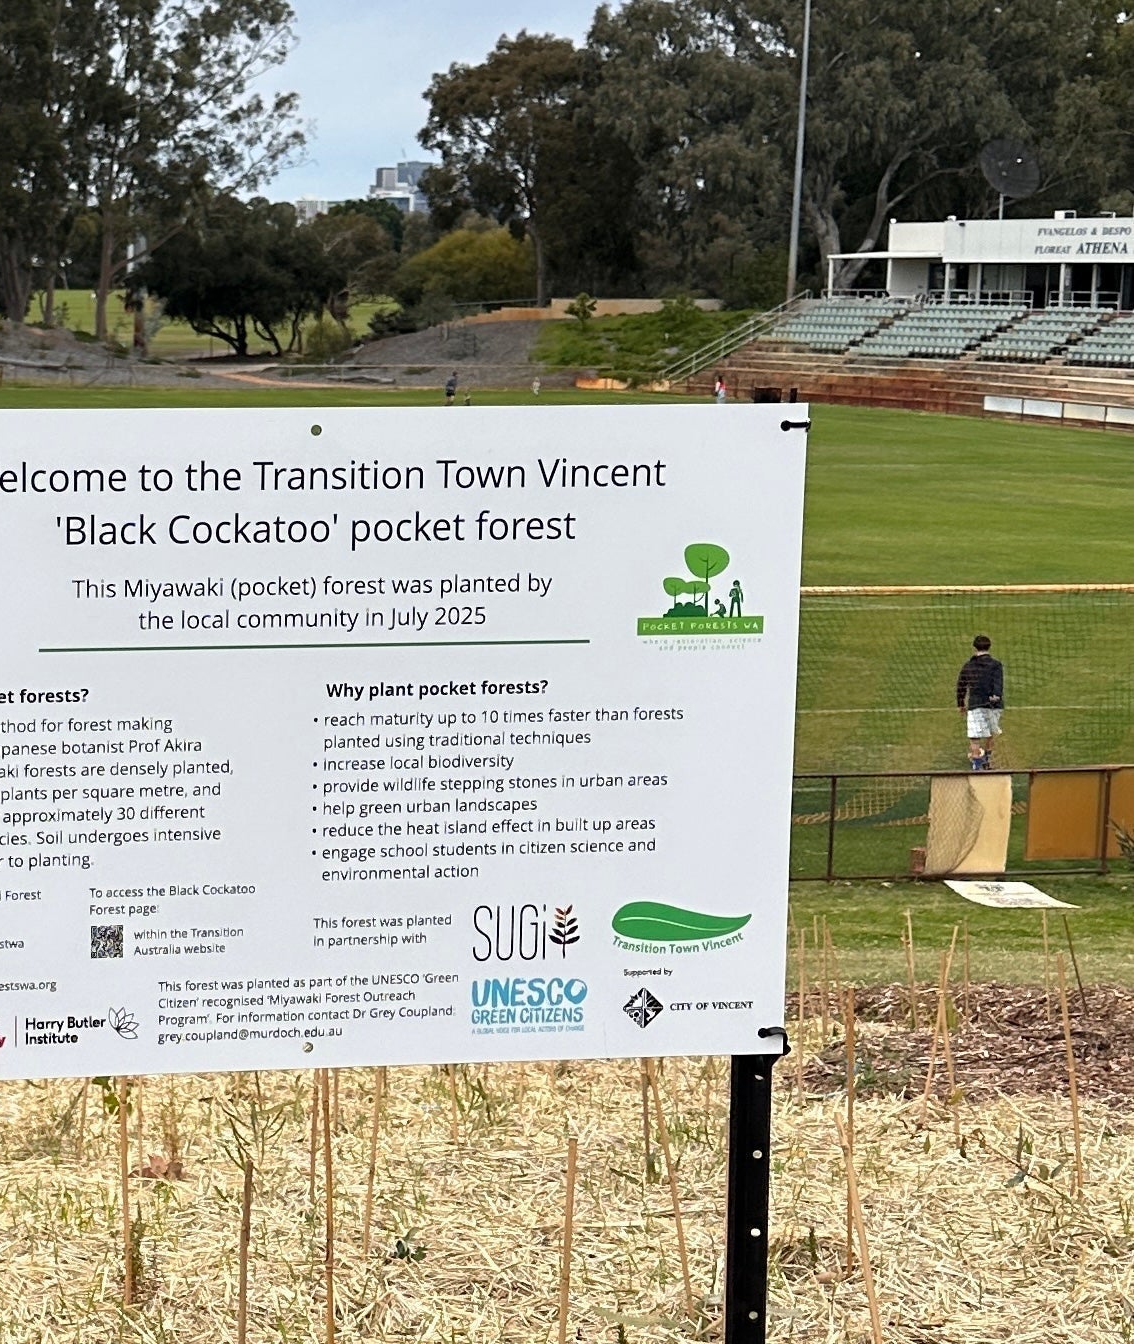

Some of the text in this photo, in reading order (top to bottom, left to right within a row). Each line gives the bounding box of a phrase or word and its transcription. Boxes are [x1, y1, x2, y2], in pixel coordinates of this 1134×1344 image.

[1034, 245, 1072, 255] FLOREAT
[1076, 242, 1128, 255] ATHENA
[137, 464, 173, 492] to
[184, 460, 242, 492] the
[252, 459, 424, 491] Transition
[435, 459, 525, 489] Town
[537, 457, 667, 488] Vincent
[56, 509, 577, 552] 'Black Cockatoo' pocket forest
[71, 572, 553, 603] This Miyawaki (pocket) forest was planted by
[138, 606, 486, 633] the local community in July 2025
[642, 620, 759, 631] POCKET FORESTS WA
[19, 688, 90, 704] forests?
[326, 679, 549, 702] Why plant pocket forests?
[40, 718, 64, 733] for
[67, 717, 113, 732] forest
[117, 716, 173, 734] making
[324, 706, 684, 729] reach maturity up to 10 times faster than forests
[61, 740, 125, 755] botanist
[128, 738, 161, 754] Prof
[163, 738, 202, 753] Akira
[324, 730, 592, 753] planted using traditional techniques
[23, 763, 77, 778] forests
[80, 765, 106, 777] are
[109, 760, 169, 779] densely
[173, 759, 234, 779] planted,
[323, 753, 515, 771] increase local biodiversity
[323, 798, 538, 819] help green urban landscapes
[7, 855, 24, 868] to
[28, 852, 94, 872] planting.
[5, 890, 42, 901] Forest
[88, 883, 256, 899] To access the Black Cockatoo
[89, 904, 126, 916] Forest
[312, 913, 452, 930] This forest was planted
[133, 927, 244, 940] within the Transition
[313, 931, 427, 950] in partnership with
[133, 943, 226, 956] Australia website
[612, 932, 744, 955] Transition Town Vincent
[663, 967, 673, 977] by
[157, 980, 182, 993] This
[185, 979, 219, 992] forest
[220, 980, 244, 990] was
[246, 976, 290, 993] planted
[293, 979, 306, 988] as
[309, 977, 333, 991] part
[335, 974, 348, 987] of
[349, 975, 369, 987] the
[371, 973, 420, 986] UNESCO
[471, 977, 588, 1008] UNESCO
[669, 1000, 754, 1011] CITY OF VINCENT
[25, 1015, 107, 1034] Harry Butler
[216, 1012, 235, 1024] For
[237, 1011, 305, 1023] information
[307, 1009, 350, 1021] contact
[352, 1008, 367, 1019] Dr
[369, 1007, 396, 1021] Grey
[470, 1006, 584, 1026] GREEN CITIZENS
[25, 1031, 79, 1046] Institute
[157, 1025, 343, 1044] grey.coupland@murdoch.edu.au
